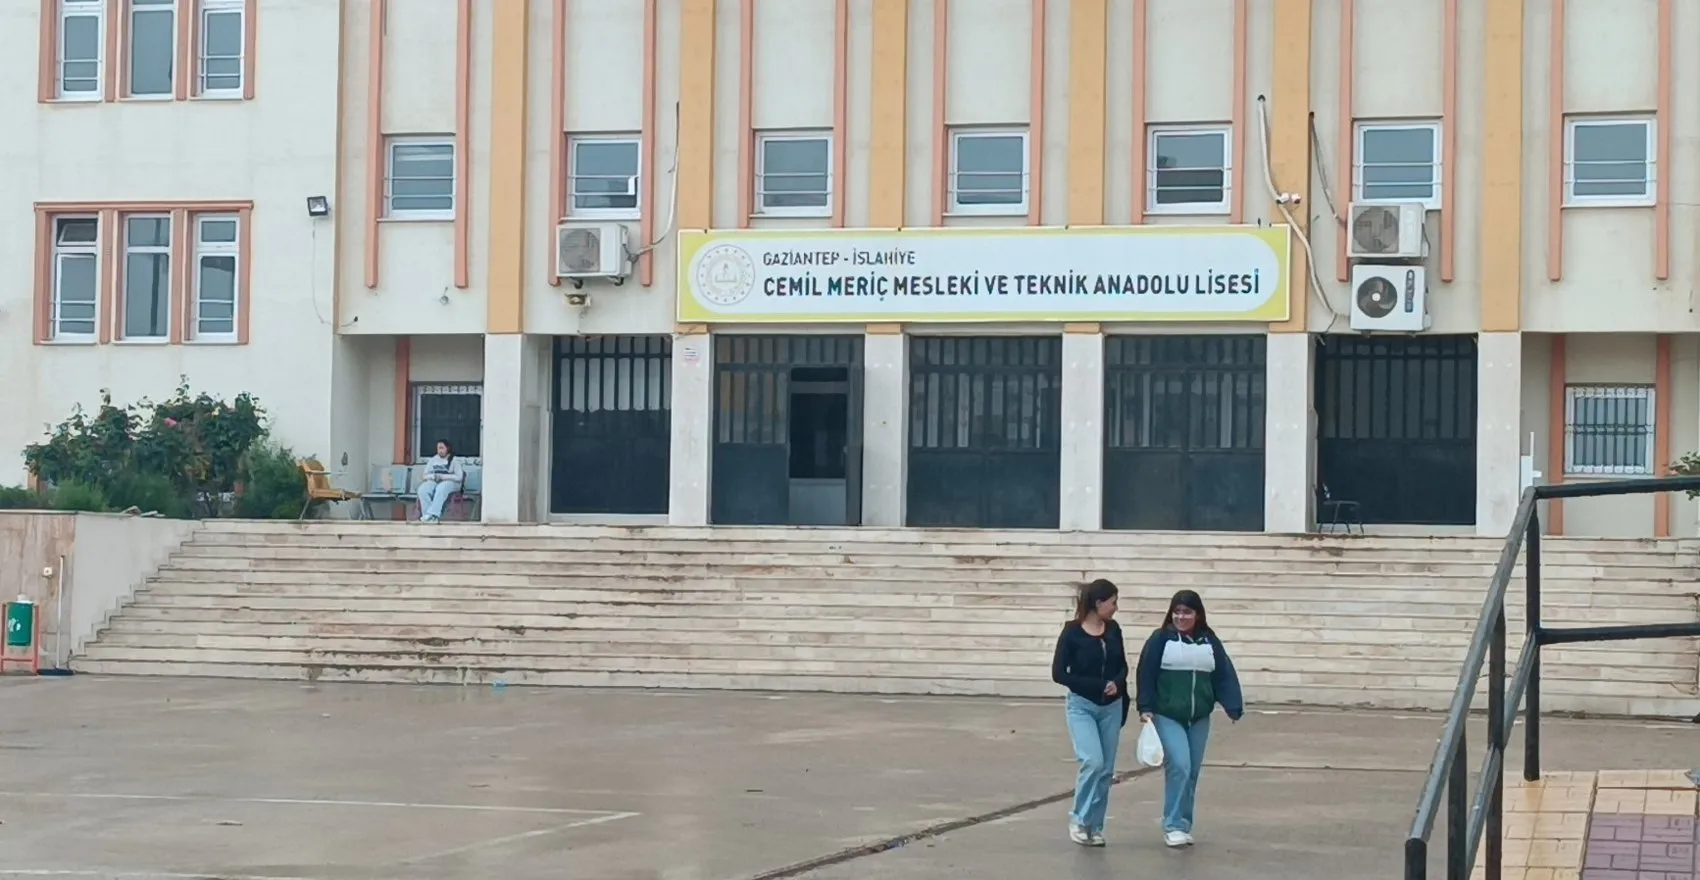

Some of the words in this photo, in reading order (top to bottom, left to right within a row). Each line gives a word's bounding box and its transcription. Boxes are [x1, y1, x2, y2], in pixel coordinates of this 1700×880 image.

[763, 249, 840, 266] GAZİANTEP
[852, 247, 916, 266] İSLAHİYE
[763, 270, 823, 297] CEMİL
[827, 270, 889, 302] MERİÇ
[893, 270, 979, 297] MESLEKİ
[984, 274, 1009, 296] VE
[1013, 270, 1089, 296] TEKNİK
[1093, 274, 1190, 296] ANADOLU
[1195, 268, 1260, 296] LİSESİ
